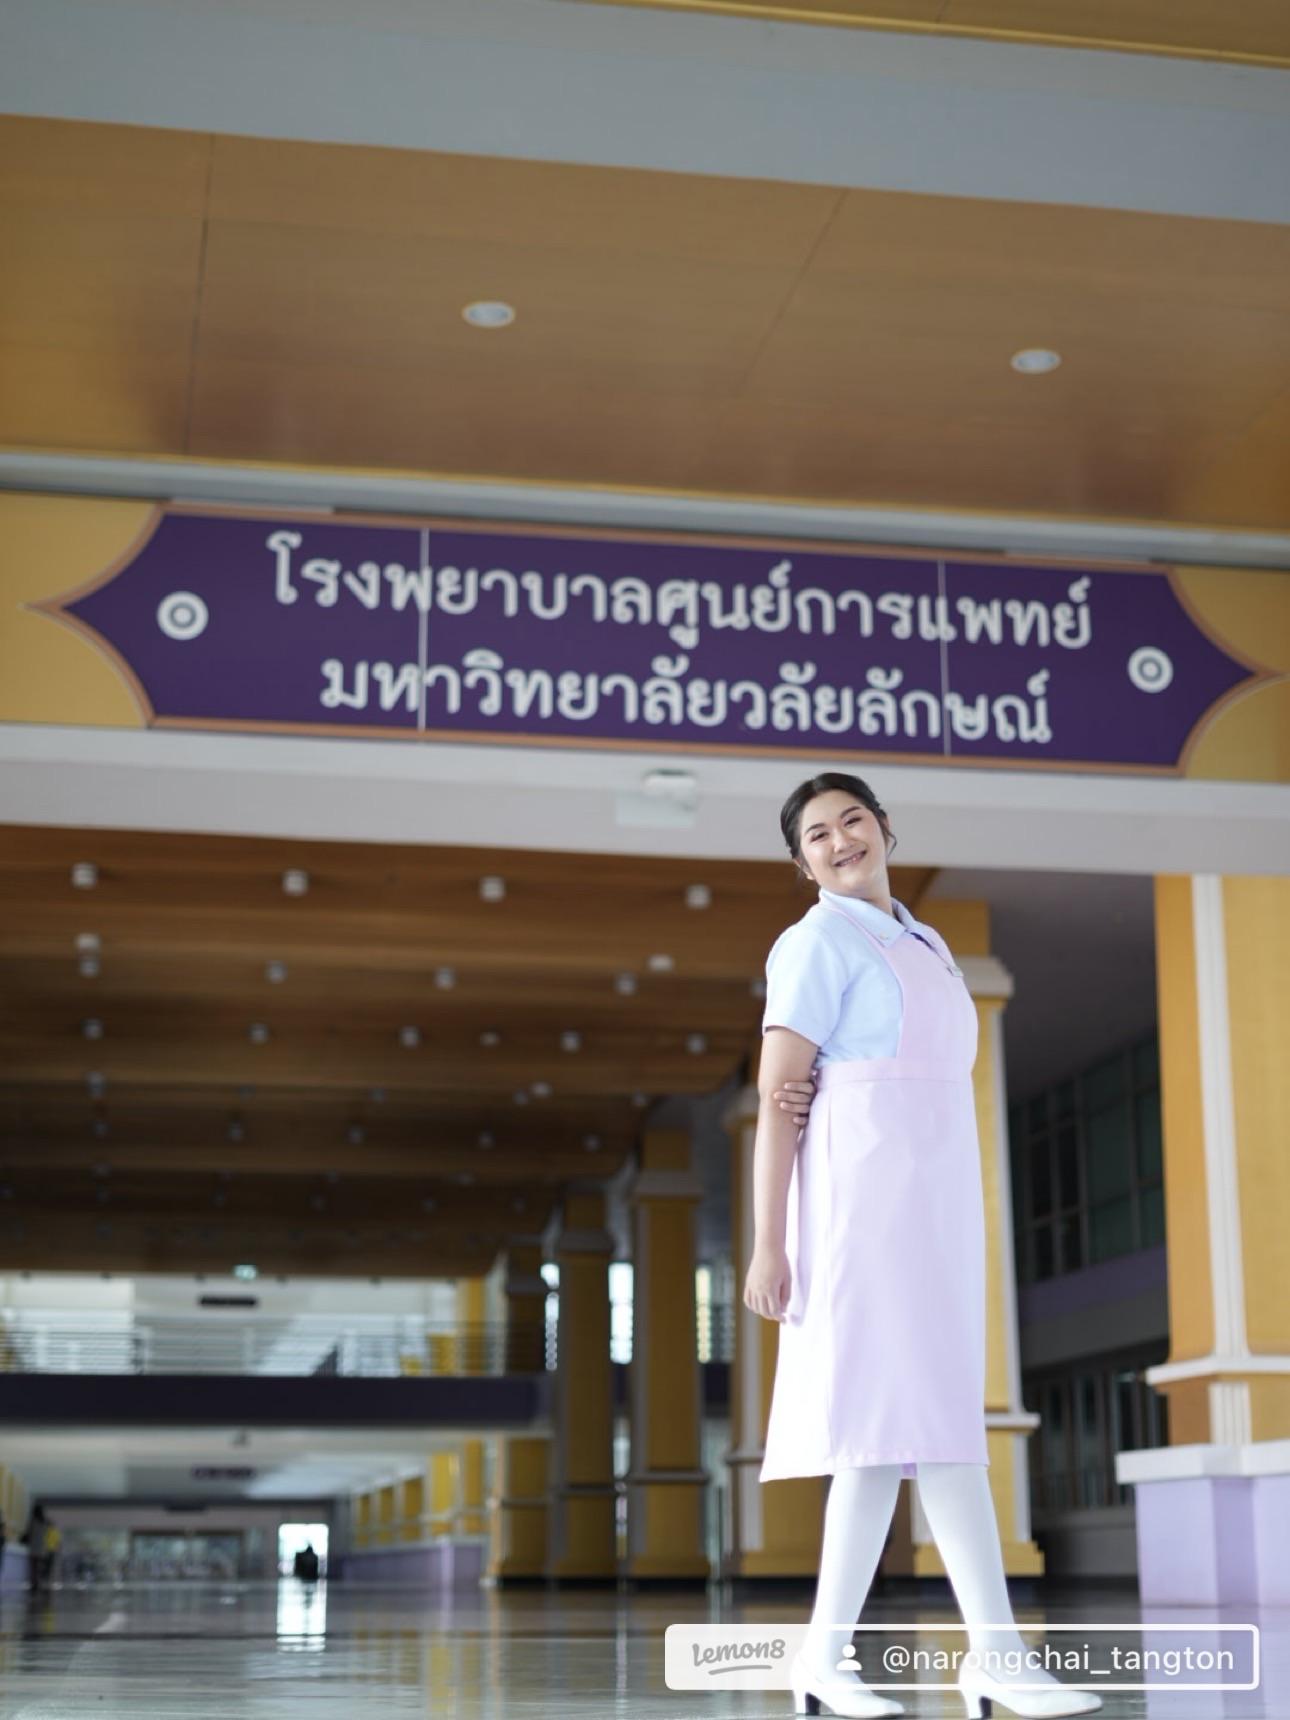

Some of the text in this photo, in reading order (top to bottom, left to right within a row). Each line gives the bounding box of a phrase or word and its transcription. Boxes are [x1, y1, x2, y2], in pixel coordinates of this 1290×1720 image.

[266, 531, 1092, 649] โรงพยาบาลศูนย์การแพทย์
[319, 648, 1053, 744] มหาวิทยาลัยวลัยลักษณ์
